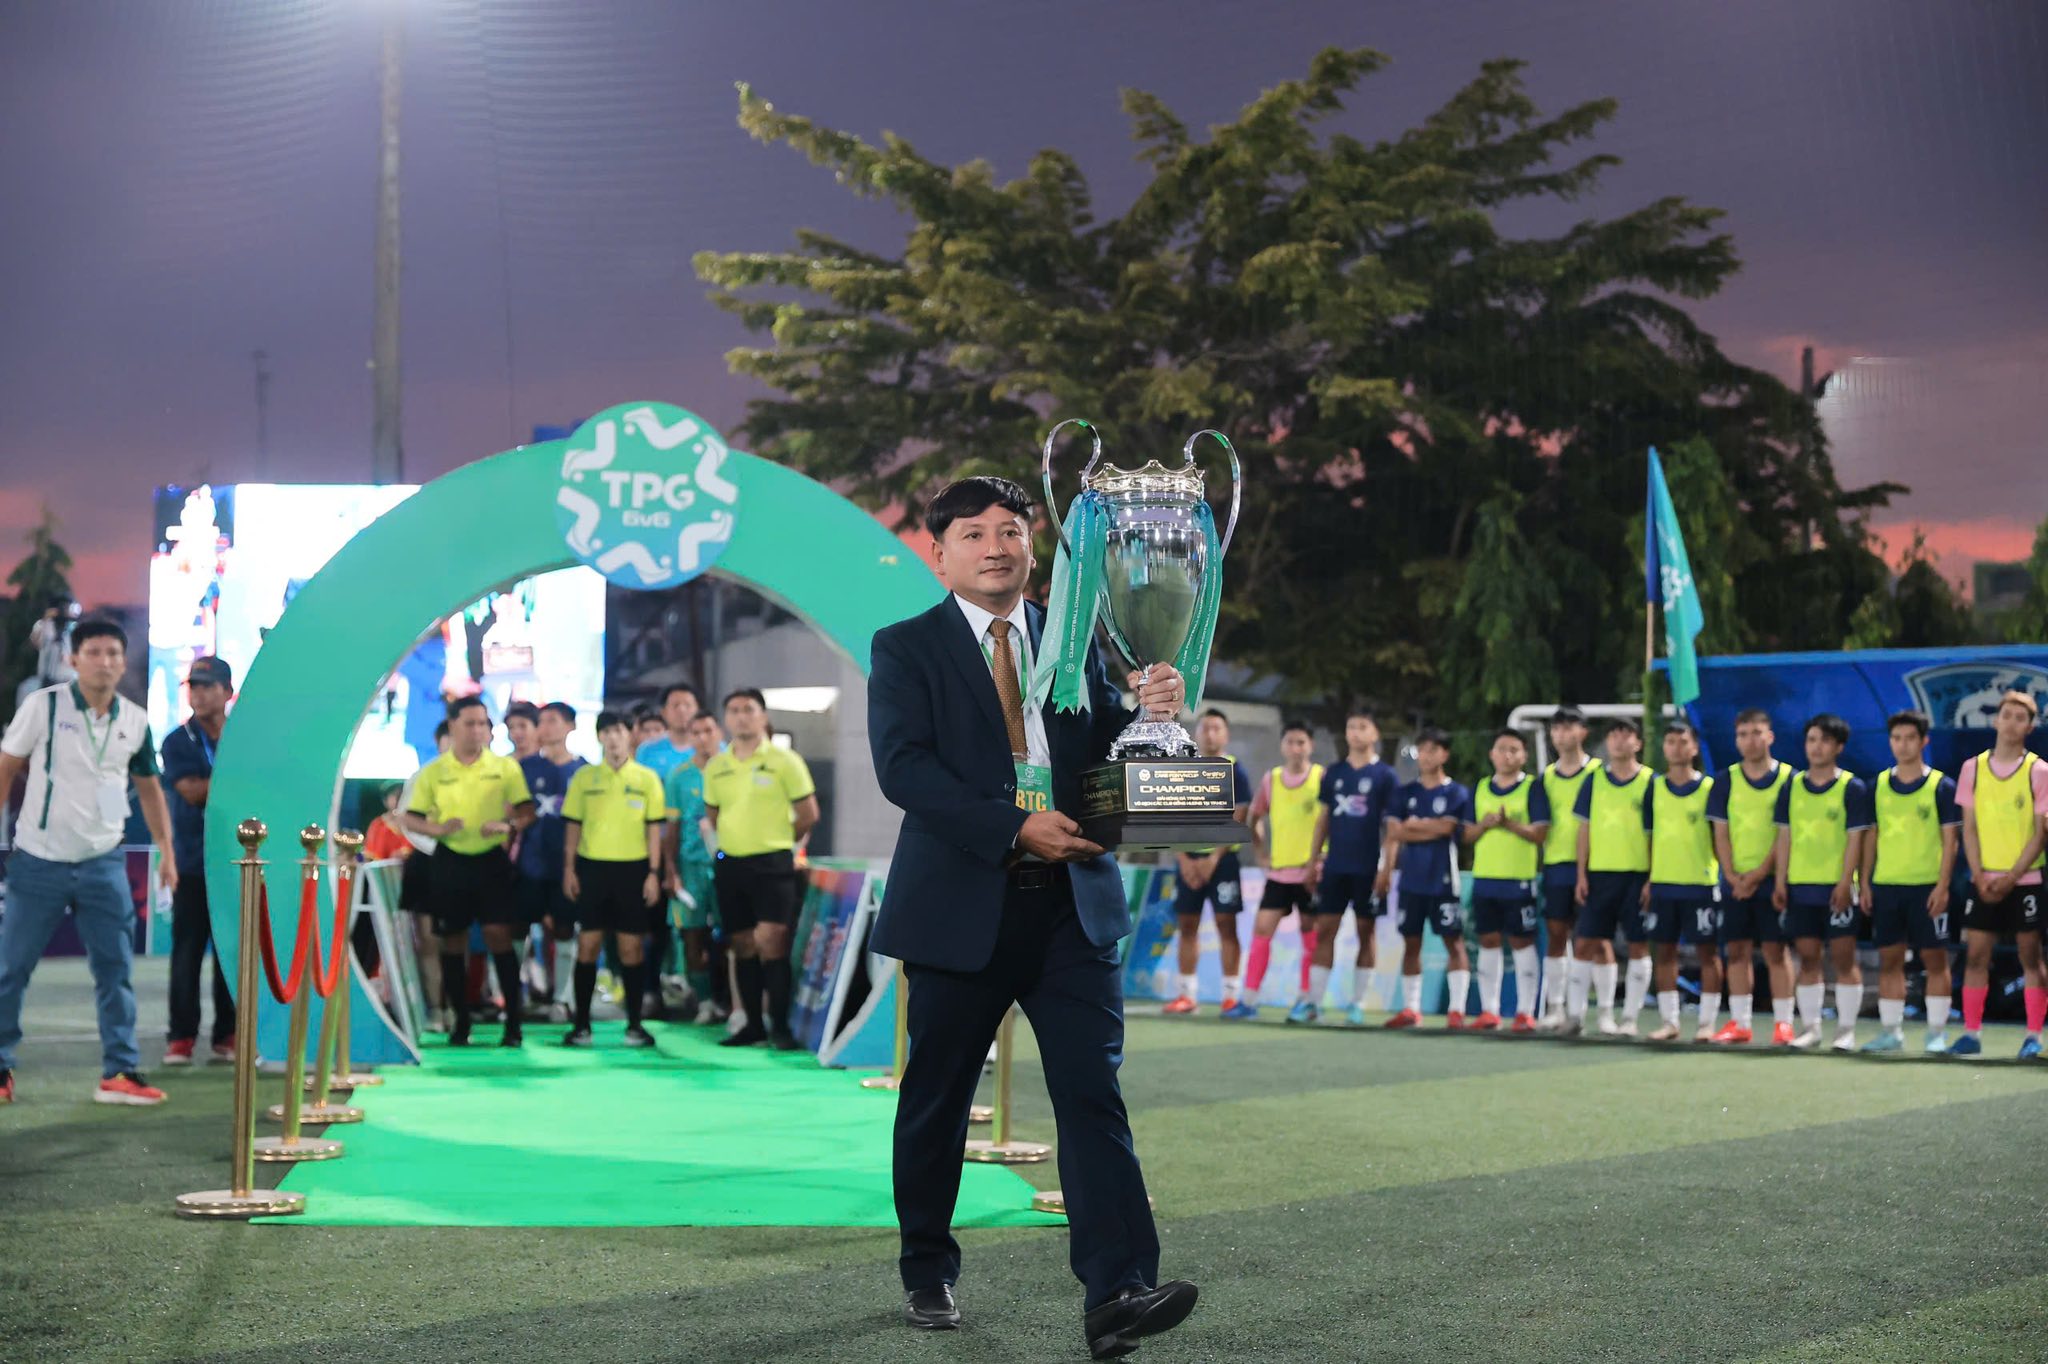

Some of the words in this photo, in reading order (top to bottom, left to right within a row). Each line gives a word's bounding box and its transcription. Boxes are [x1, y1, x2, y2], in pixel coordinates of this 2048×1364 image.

[601, 470, 696, 511] TPG
[1073, 561, 1083, 609] CHAMPIONSHIP
[1070, 608, 1079, 641] FOOTBALL
[1186, 620, 1199, 650] FOOTBALL
[1196, 643, 1204, 660] CLUB
[1201, 613, 1210, 643] FOOTBALL
[1016, 789, 1047, 812] BTC
[1140, 785, 1220, 793] CHAMPIONS
[2023, 894, 2038, 918] 3
